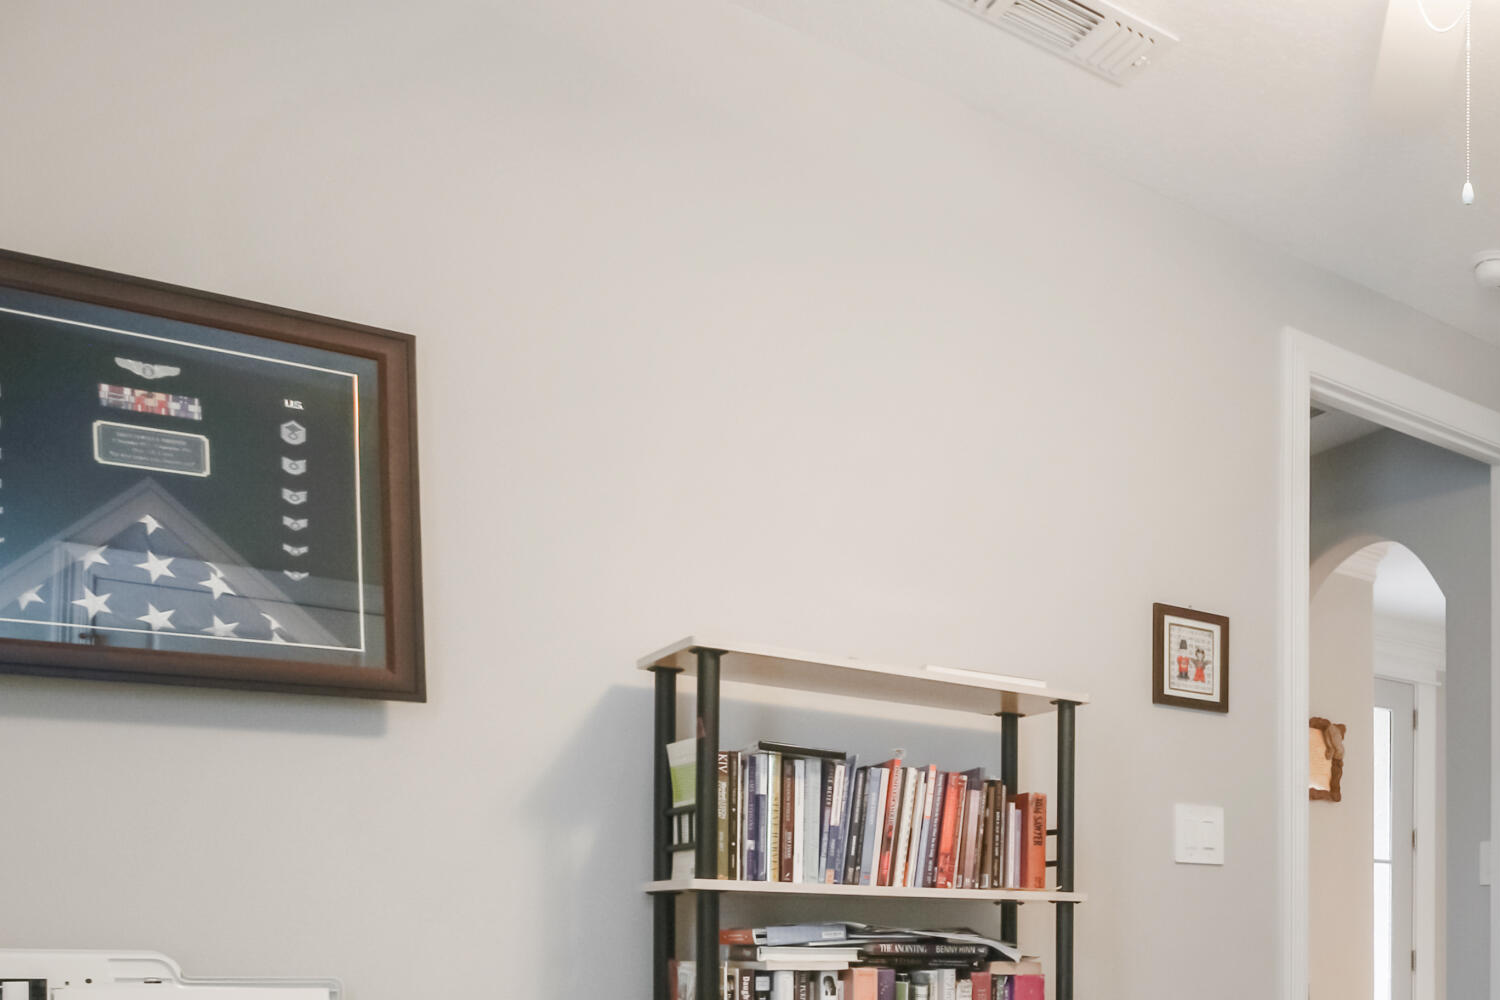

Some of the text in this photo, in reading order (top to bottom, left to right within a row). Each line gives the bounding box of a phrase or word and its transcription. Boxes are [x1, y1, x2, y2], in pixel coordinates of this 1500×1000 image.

[1033, 815, 1043, 846] SAWYER
[879, 943, 893, 953] THE
[935, 944, 958, 954] BENNY
